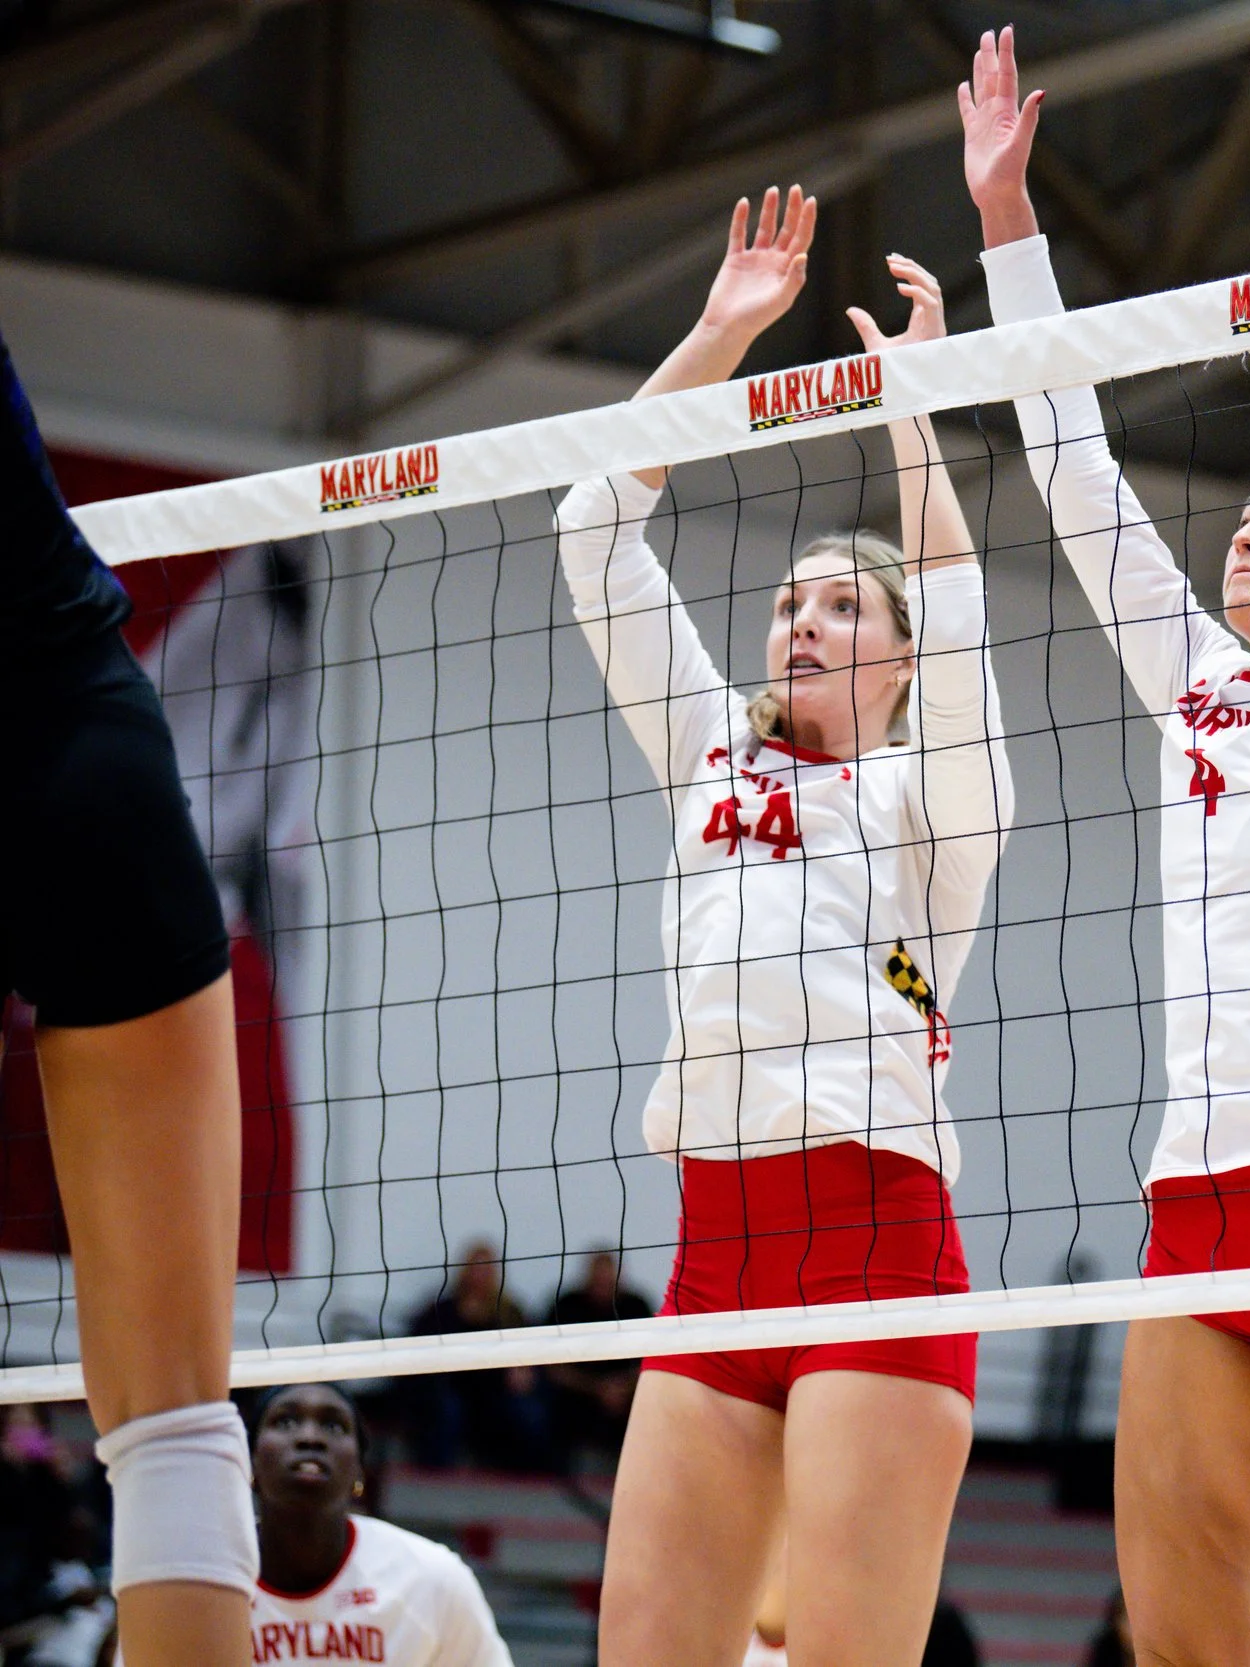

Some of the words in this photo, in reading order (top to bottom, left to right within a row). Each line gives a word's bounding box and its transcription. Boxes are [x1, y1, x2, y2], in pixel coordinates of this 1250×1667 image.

[747, 353, 883, 422] MARYLAND
[320, 444, 439, 504] MARYLAND
[1183, 747, 1226, 817] 4
[702, 791, 803, 860] 44
[250, 1620, 386, 1664] ARYLAND
